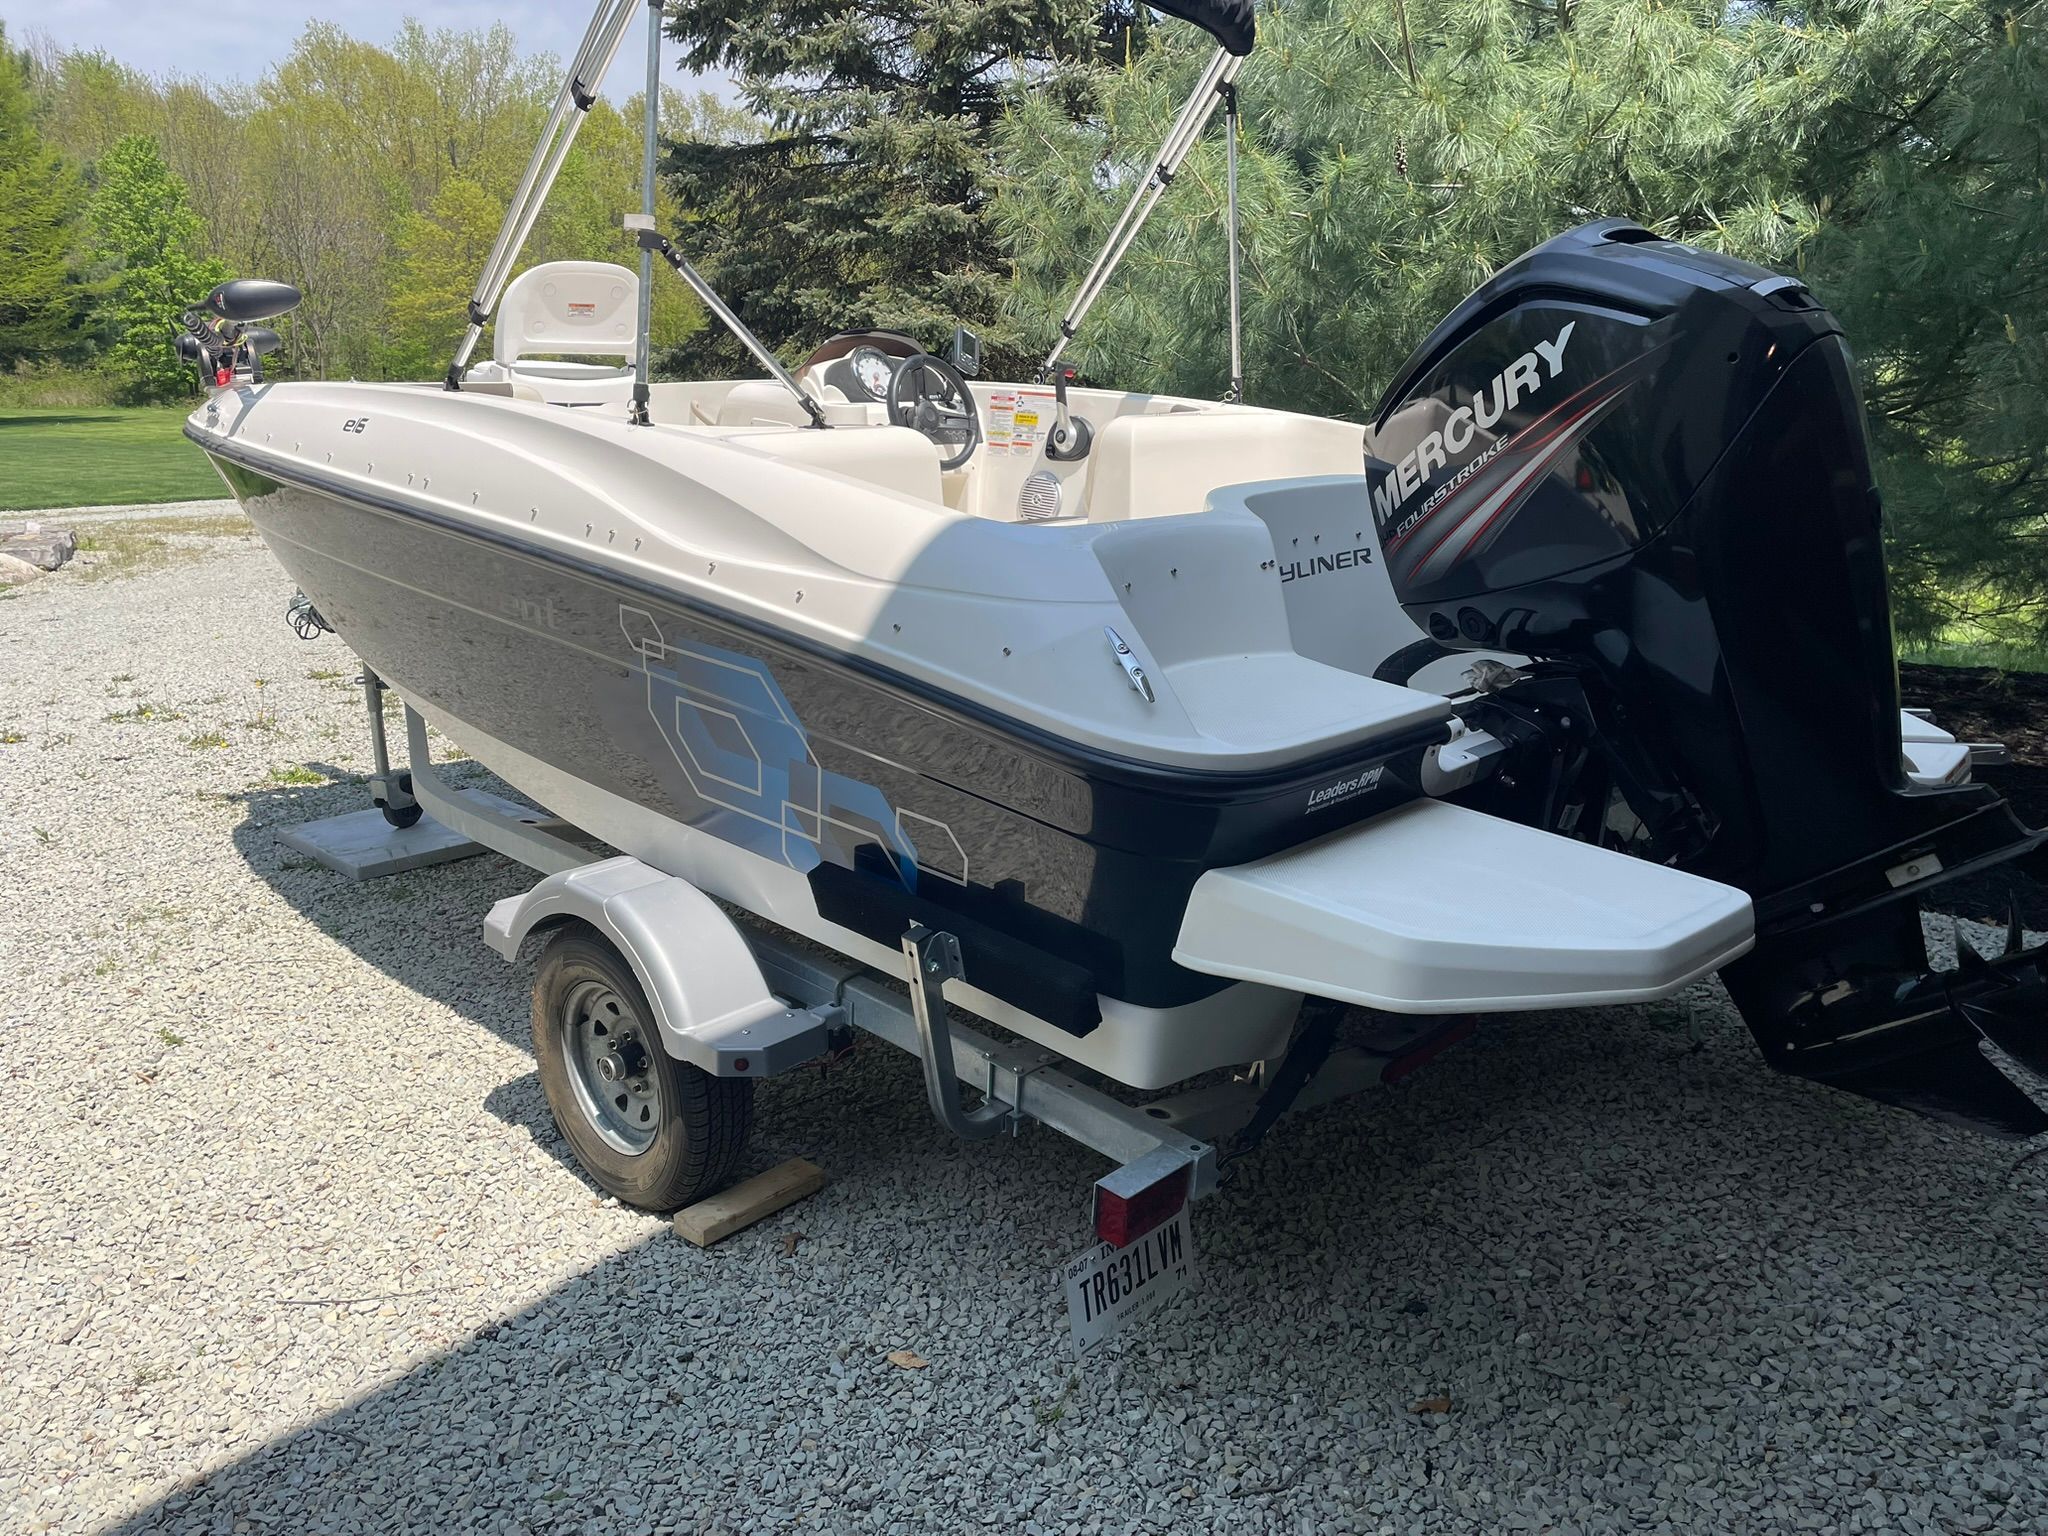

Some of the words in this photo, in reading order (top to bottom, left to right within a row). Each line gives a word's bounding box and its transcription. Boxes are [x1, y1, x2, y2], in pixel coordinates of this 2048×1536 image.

[1374, 320, 1575, 526] MERCURY
[1397, 433, 1509, 538] FOURSTROKE
[1279, 547, 1373, 583] YLINER
[1307, 778, 1358, 806] Leaders
[1357, 766, 1385, 788] RPM
[1079, 1220, 1183, 1323] TR631LVM
